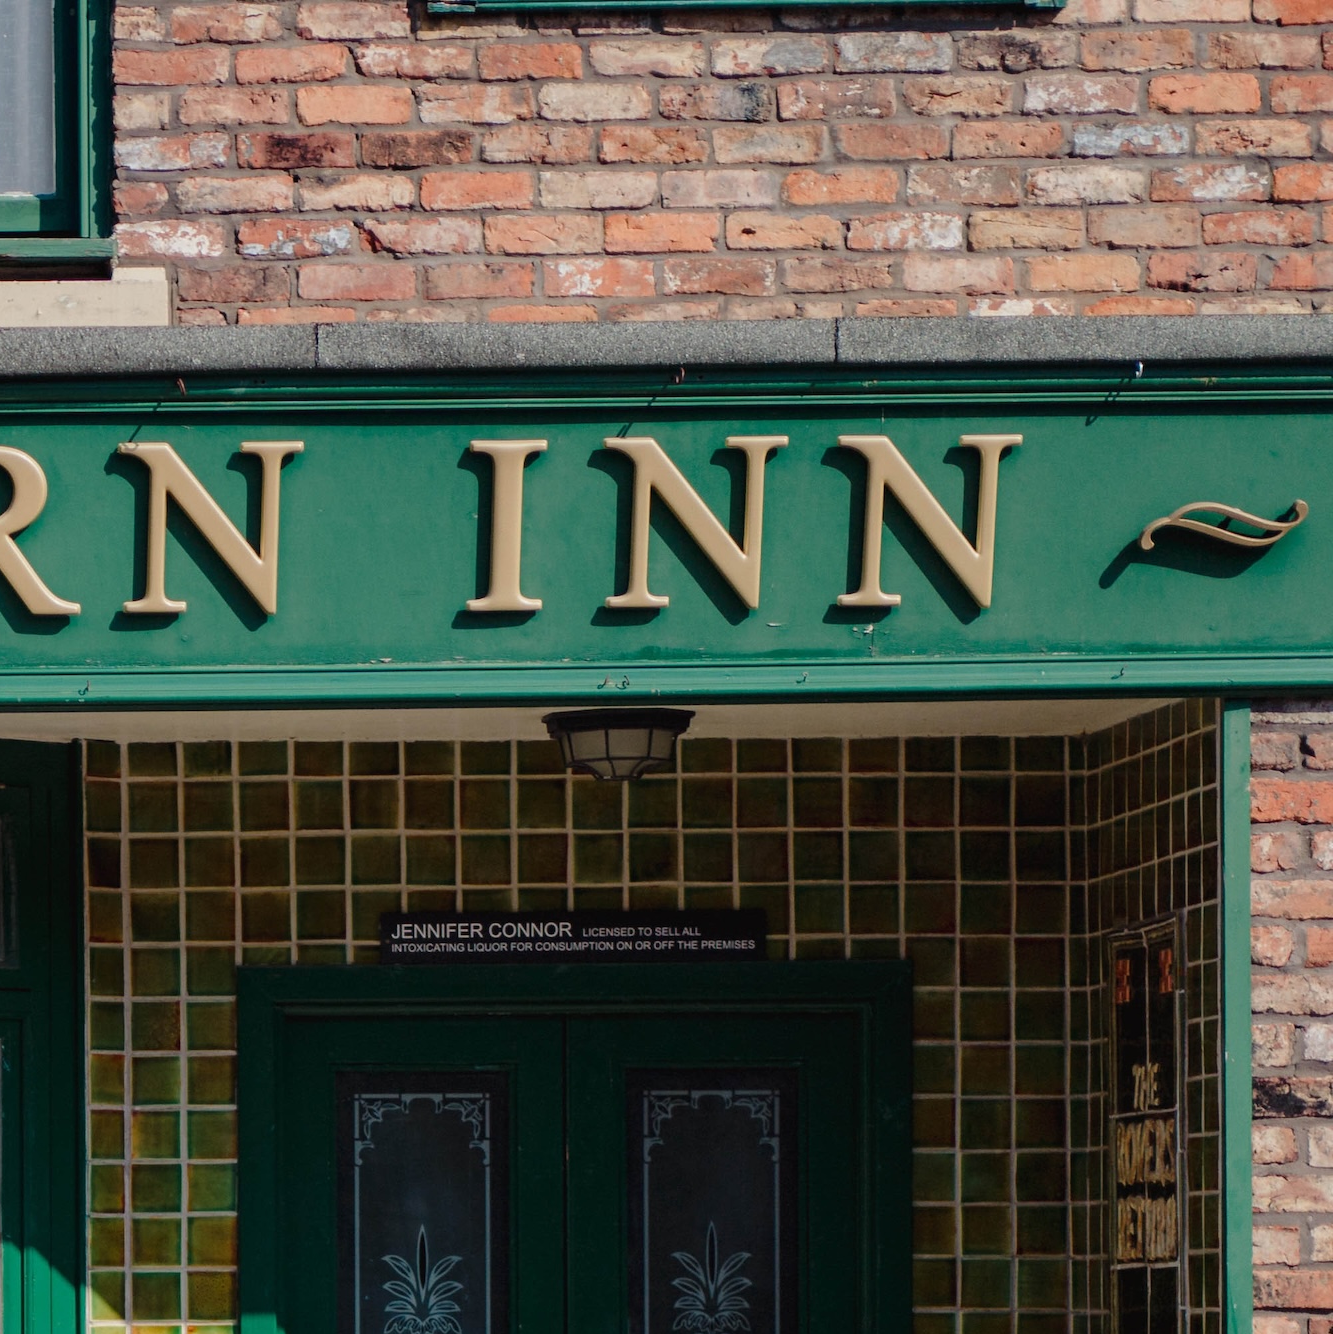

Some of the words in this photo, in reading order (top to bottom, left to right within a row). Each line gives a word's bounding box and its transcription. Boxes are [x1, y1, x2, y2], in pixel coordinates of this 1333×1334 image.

[464, 432, 1025, 612] INN
[391, 922, 484, 940] JENNIFER
[488, 921, 573, 939] CONNOR
[582, 926, 636, 938] LICENSED
[637, 926, 653, 937] TO
[654, 925, 681, 937] SELL
[682, 925, 702, 937] ALL
[391, 942, 465, 953] INTOXICATING
[467, 942, 509, 953] LIQUOR
[510, 941, 533, 952] FOR
[535, 941, 615, 952] CONSUMPTION
[617, 940, 633, 951] ON
[634, 940, 652, 951] OR
[653, 940, 675, 950] OFF
[677, 939, 699, 950] THE
[700, 939, 756, 950] PREMISES
[1132, 1062, 1161, 1111] THE
[1116, 1118, 1177, 1187] ROVERS
[1117, 1195, 1178, 1262] RETURN
